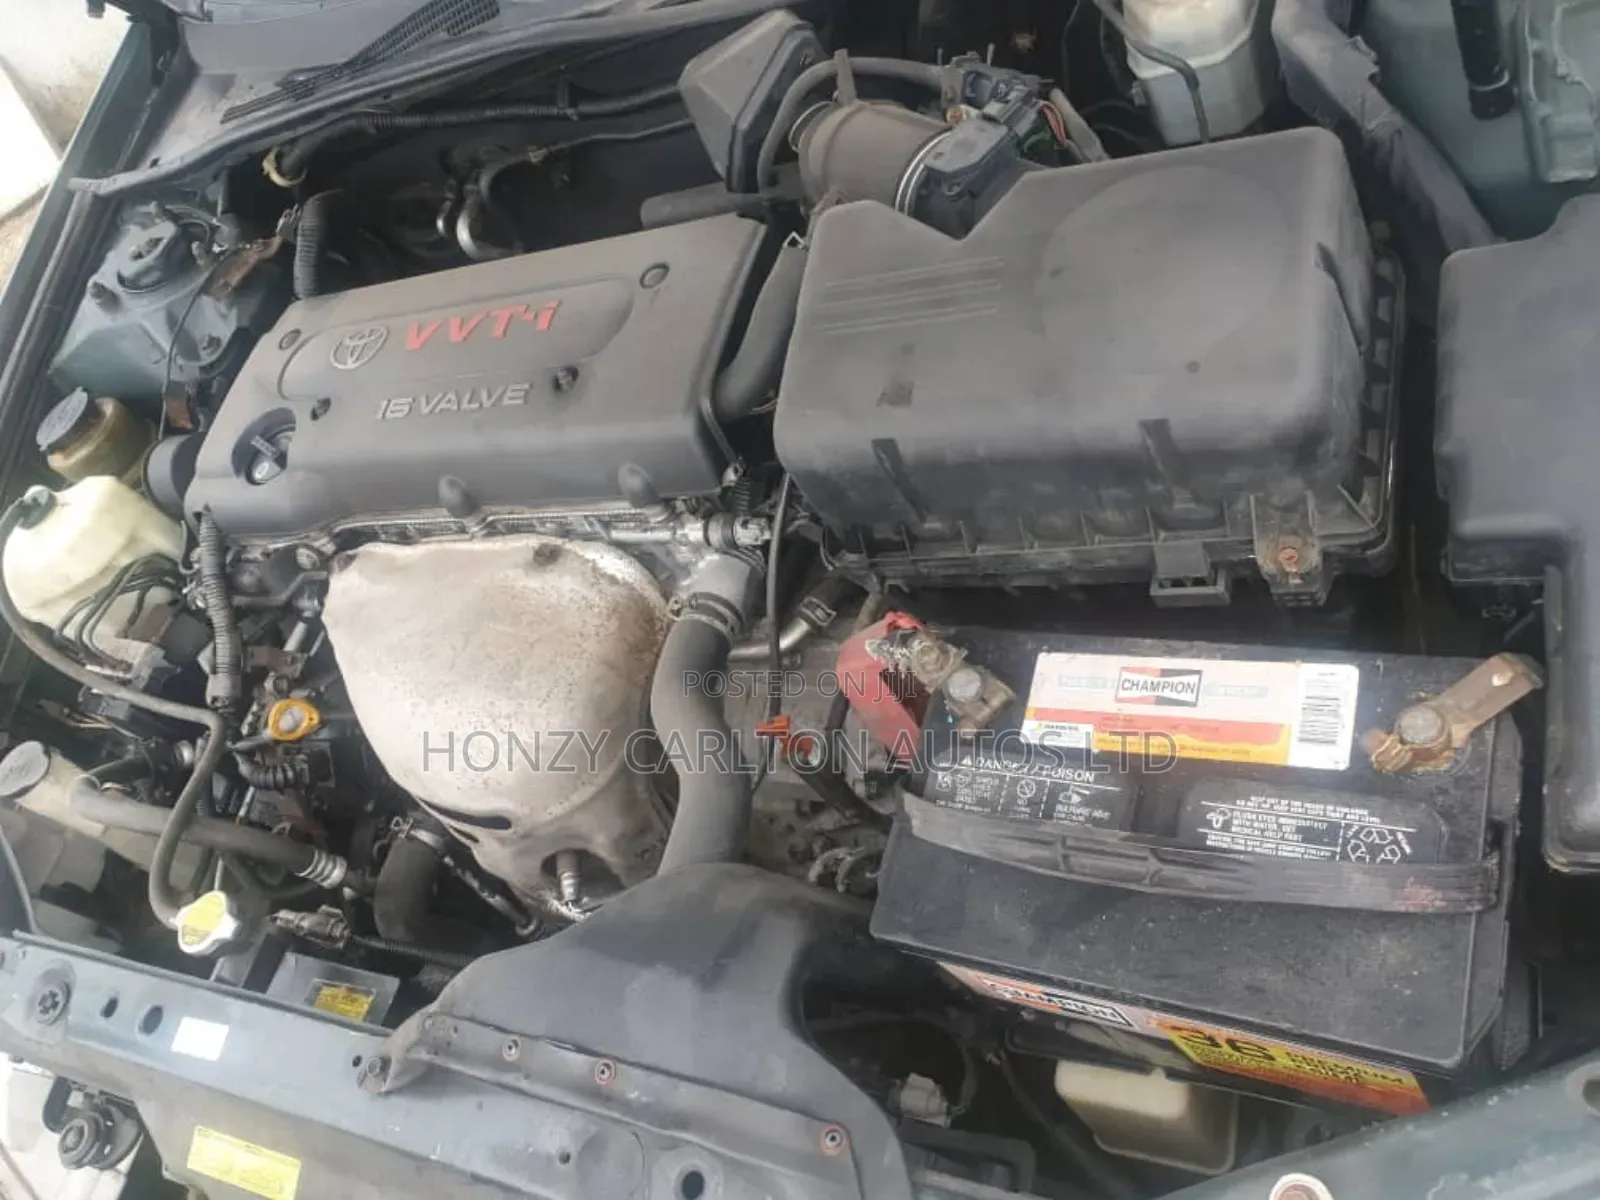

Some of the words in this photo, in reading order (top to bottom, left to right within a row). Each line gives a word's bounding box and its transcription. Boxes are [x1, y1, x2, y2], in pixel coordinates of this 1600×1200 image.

[377, 397, 416, 420] 16
[418, 383, 533, 415] VALVE
[1120, 677, 1197, 696] CHAMPION
